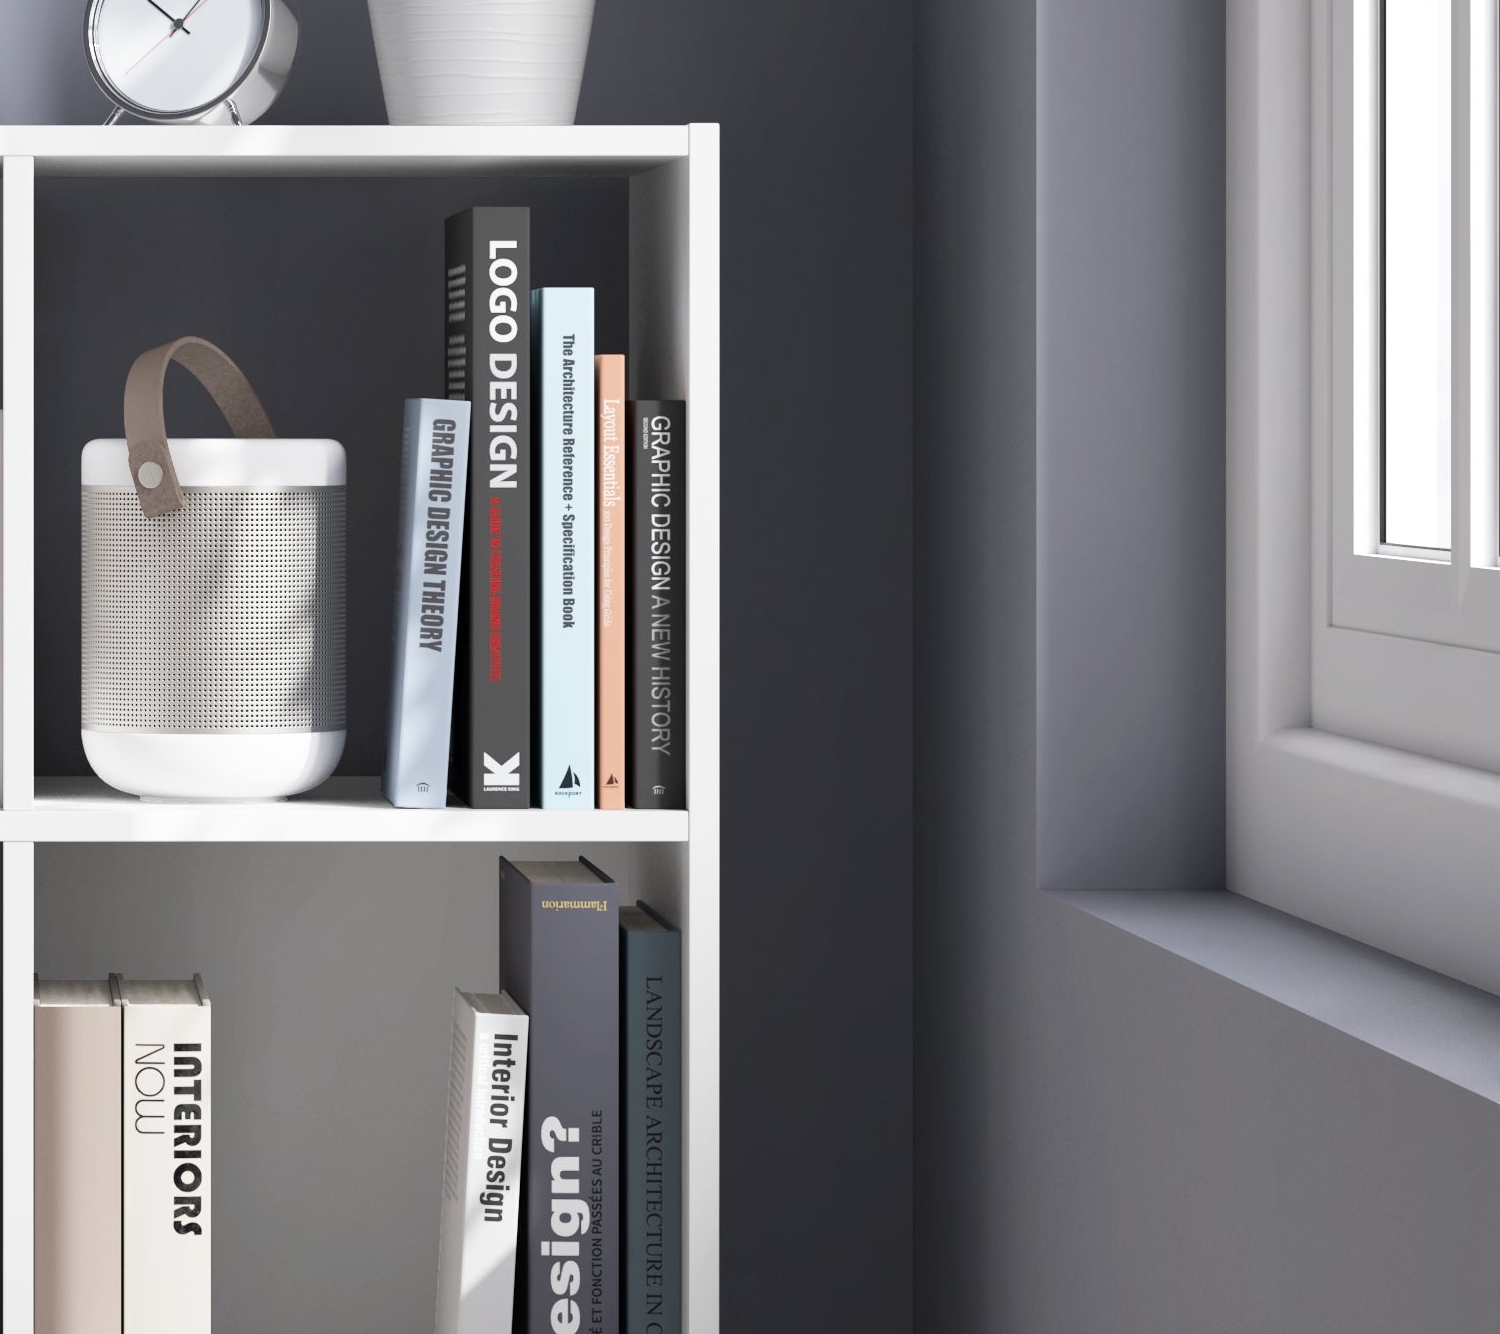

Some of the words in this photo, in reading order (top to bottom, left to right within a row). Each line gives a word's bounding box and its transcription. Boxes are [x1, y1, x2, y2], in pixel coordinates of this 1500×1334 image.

[489, 241, 517, 342] LOGO
[563, 334, 575, 355] The
[489, 354, 517, 488] DESIGN
[563, 359, 575, 435] Architecture
[600, 399, 620, 441] Layout
[428, 419, 457, 503] GRAPHIC
[563, 439, 575, 500] Reference
[603, 445, 620, 506] Essentials
[651, 416, 671, 507] GRAPHIC
[565, 503, 573, 512] +
[602, 523, 612, 545] Design
[423, 507, 451, 575] DESIGN
[490, 537, 501, 548] TO
[562, 515, 575, 595] Specification
[602, 546, 612, 577] Principles
[651, 514, 671, 590] DESIGN
[563, 599, 575, 628] Book
[603, 579, 612, 588] for
[651, 595, 670, 609] A
[419, 580, 446, 652] THEORY
[651, 615, 671, 660] NEW
[651, 667, 671, 754] HISTORY
[541, 900, 607, 912] Flammarion
[476, 1043, 490, 1085] critical
[644, 977, 663, 1108] LANDSCAPE
[134, 1044, 165, 1134] NOW
[490, 1034, 518, 1128] Interior
[173, 1044, 202, 1235] INTERIORS
[472, 1088, 487, 1159] introduction
[592, 1111, 602, 1154] CRIBLE
[480, 1138, 513, 1222] Design
[592, 1159, 602, 1175] AU
[592, 1179, 604, 1234] PASSÉES
[644, 1115, 663, 1286] ARCHITECTURE
[592, 1239, 602, 1304] FONCTION
[592, 1308, 602, 1323] ET
[644, 1293, 663, 1315] IN
